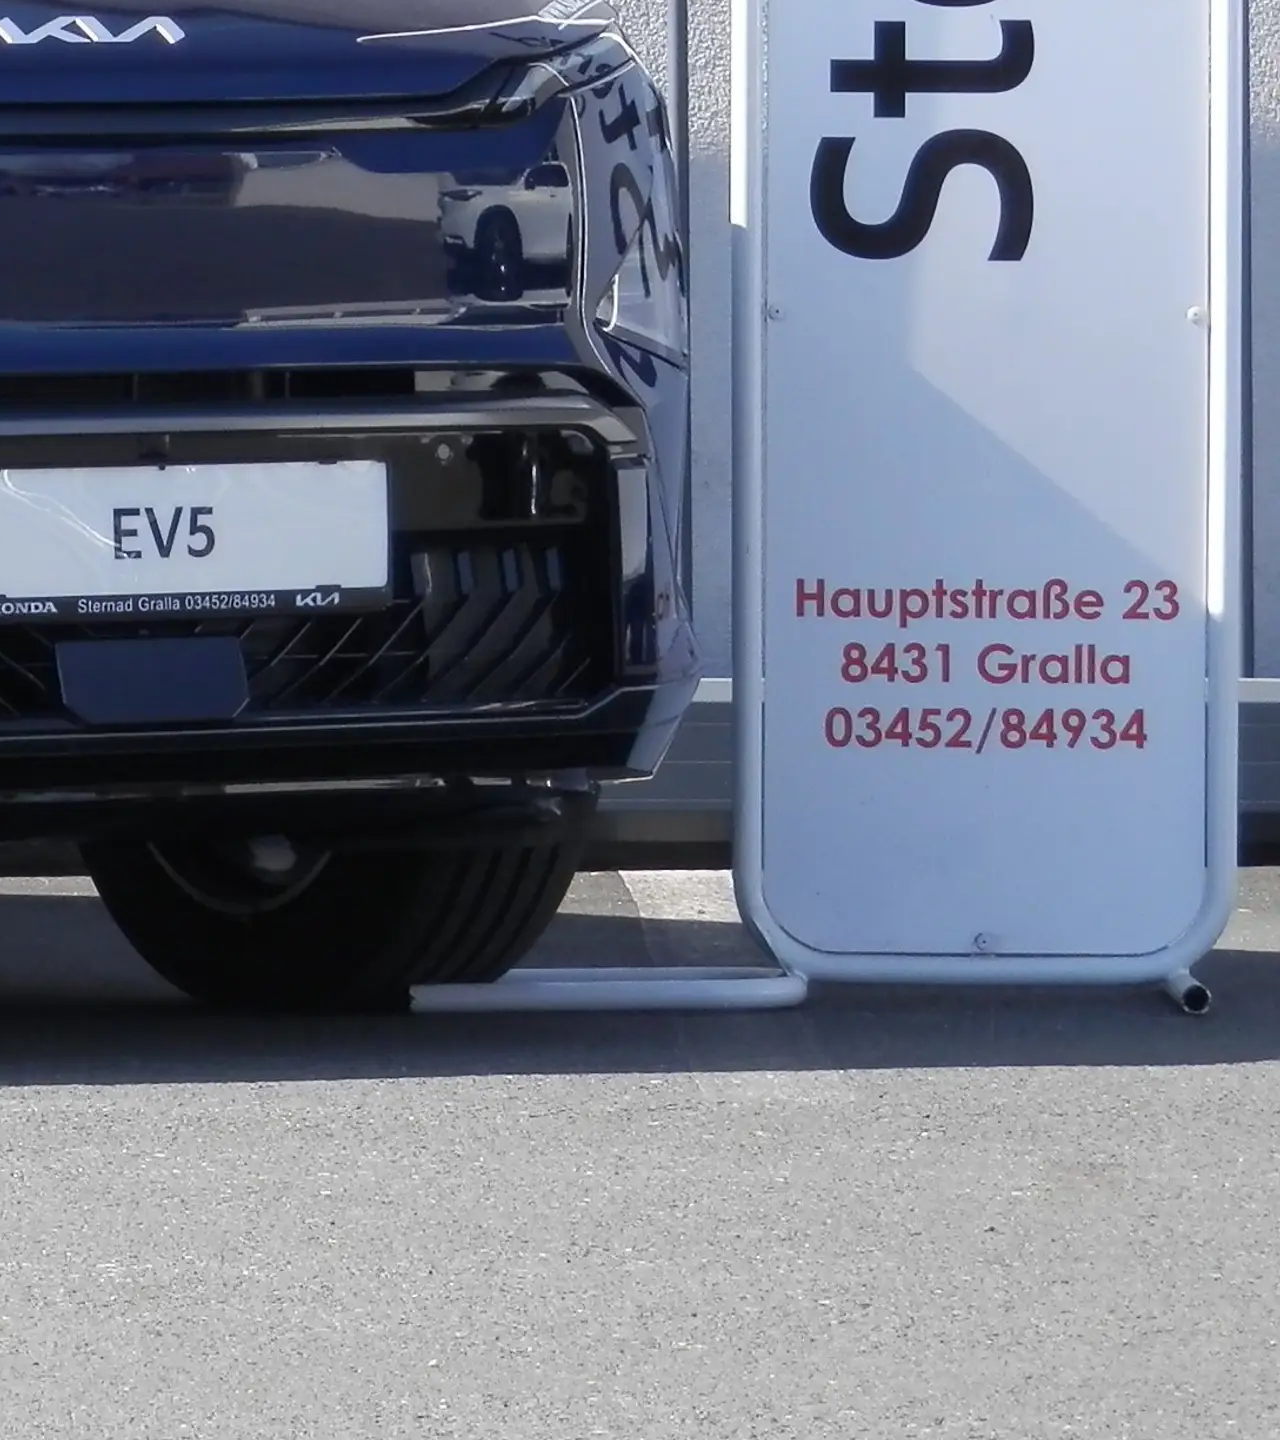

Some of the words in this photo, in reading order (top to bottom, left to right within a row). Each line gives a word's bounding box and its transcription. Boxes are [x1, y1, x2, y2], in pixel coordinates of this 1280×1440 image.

[112, 506, 215, 559] EV5
[78, 597, 132, 613] Sternad
[138, 596, 180, 611] Gralla
[185, 593, 276, 610] 03452/84934
[796, 578, 1104, 628] Hauptstraße
[1122, 579, 1180, 620] 23
[841, 642, 951, 683] 8431
[977, 643, 1131, 684] Gralla
[825, 707, 1148, 754] 03452/84934
